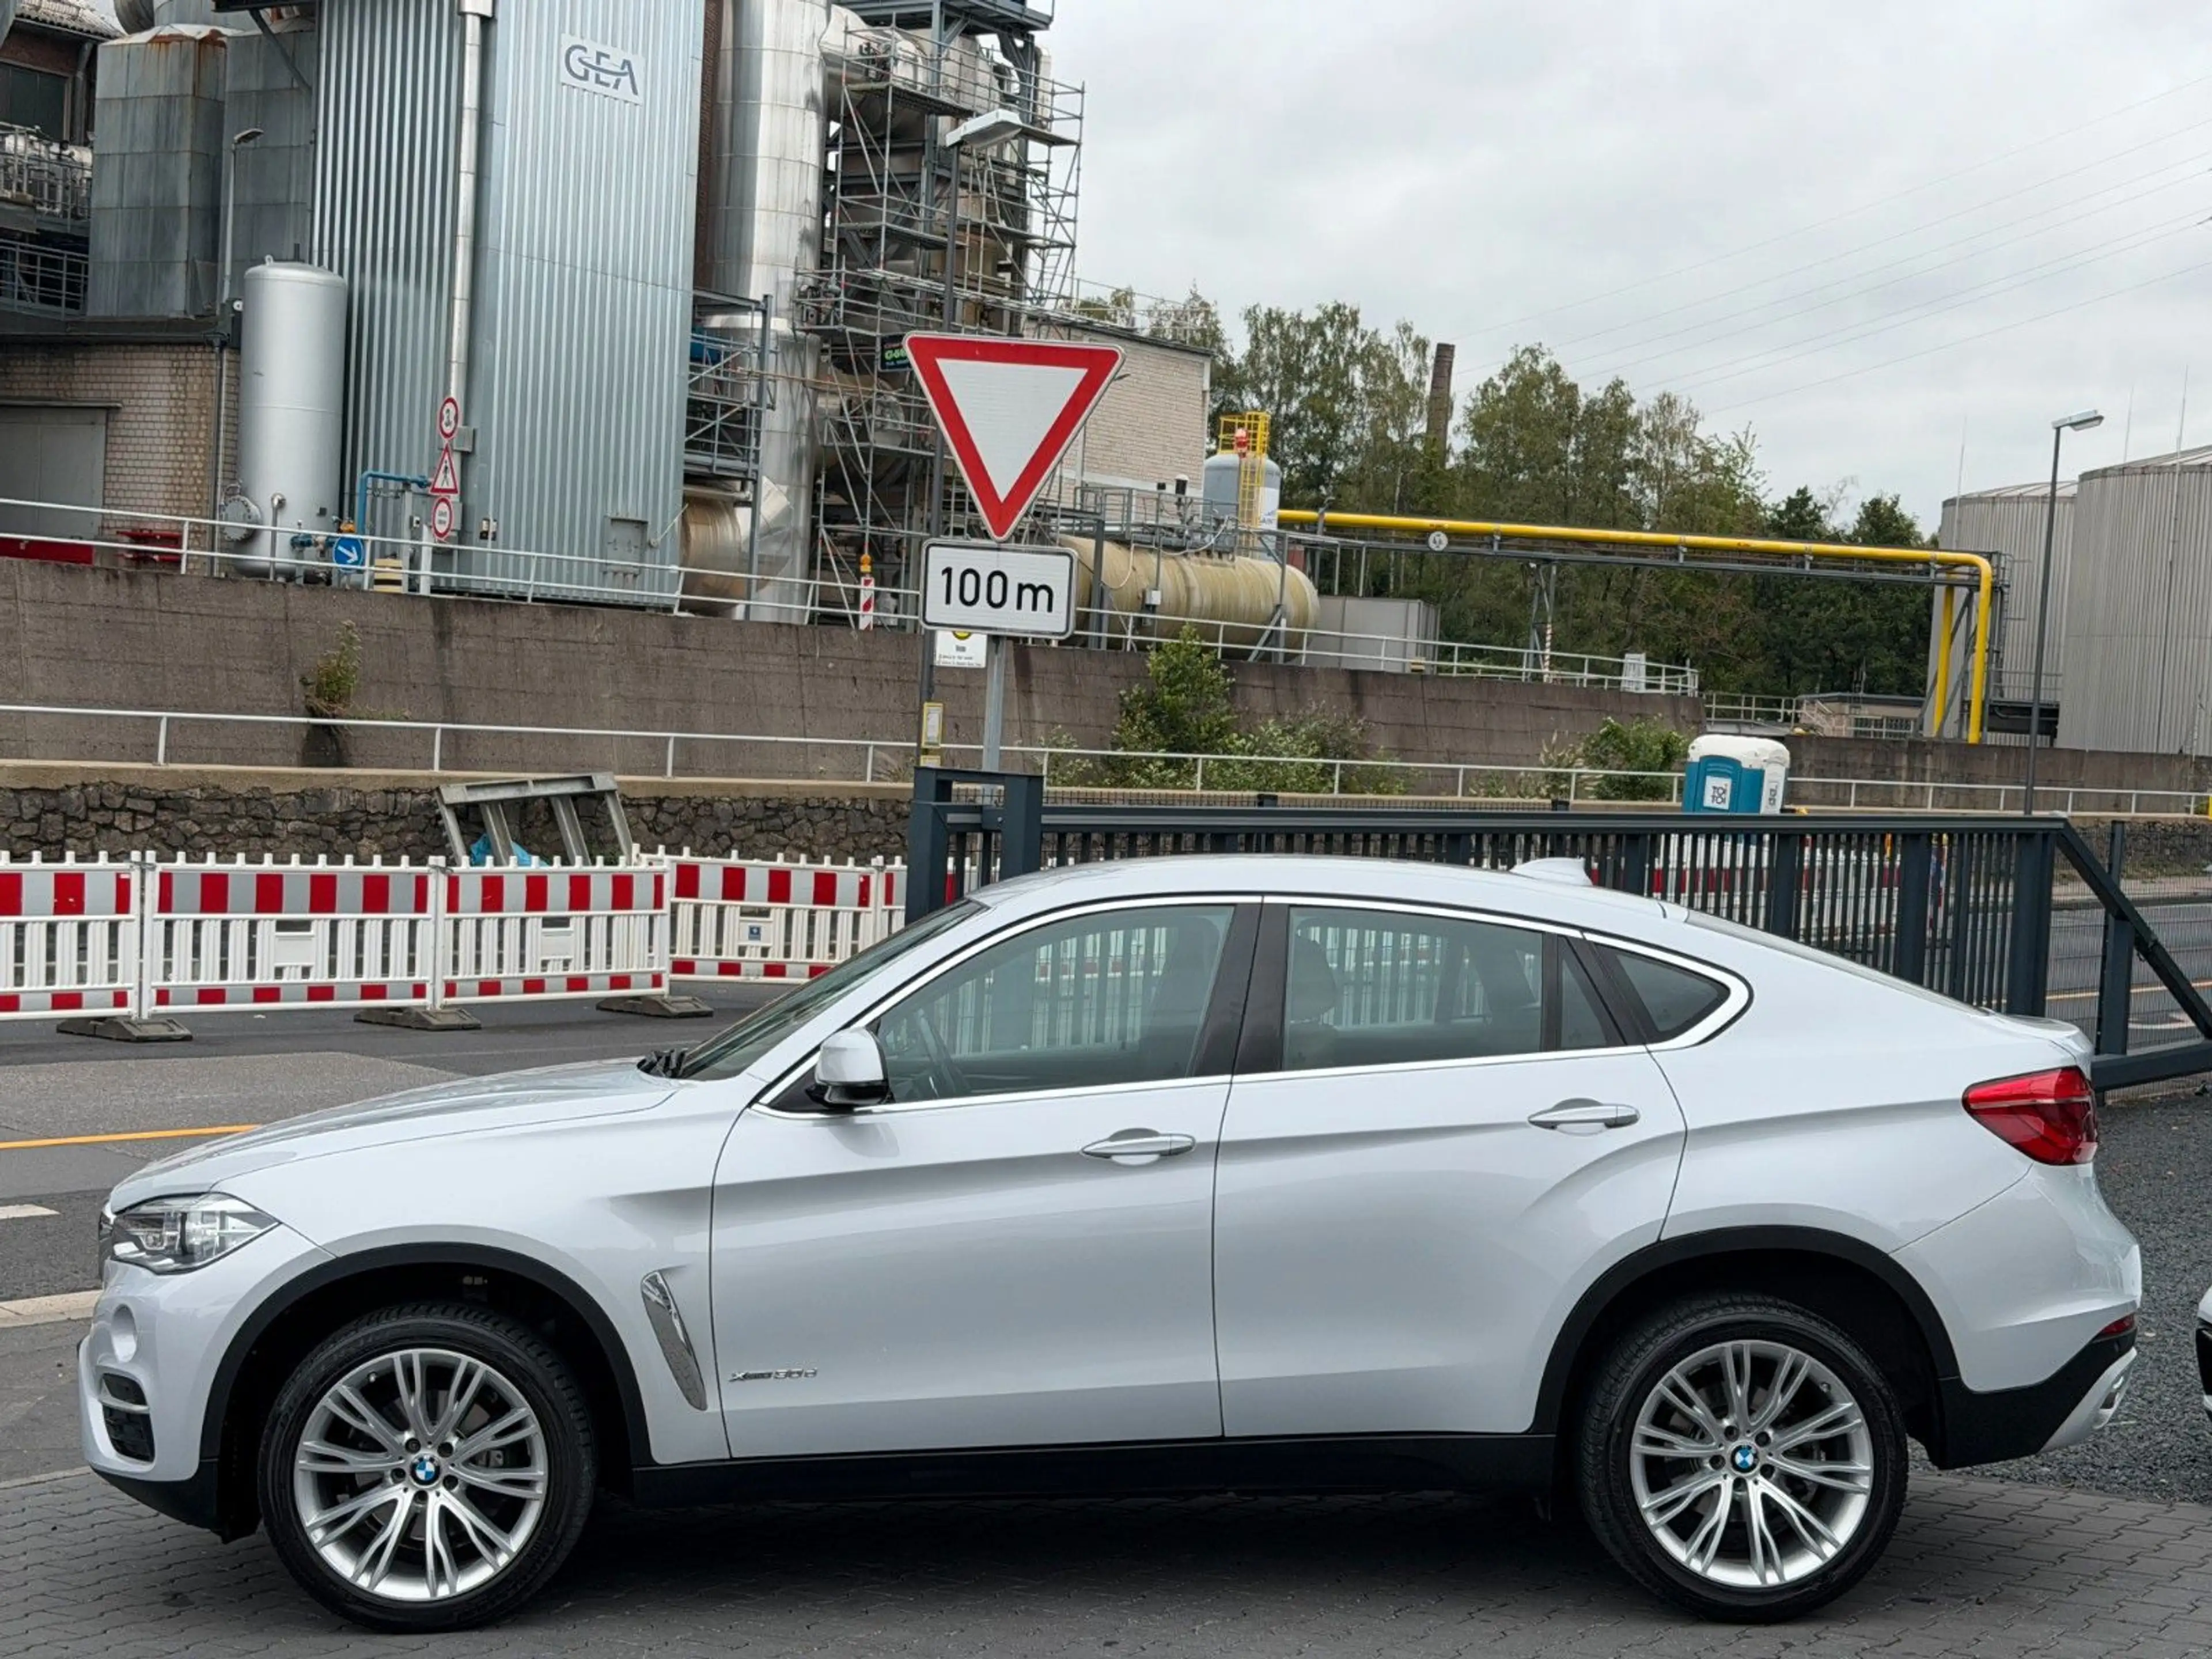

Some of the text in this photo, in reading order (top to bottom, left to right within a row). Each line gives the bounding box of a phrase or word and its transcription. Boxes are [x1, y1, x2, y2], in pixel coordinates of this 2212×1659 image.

[565, 44, 638, 96] GEA
[942, 566, 1054, 613] 100 m
